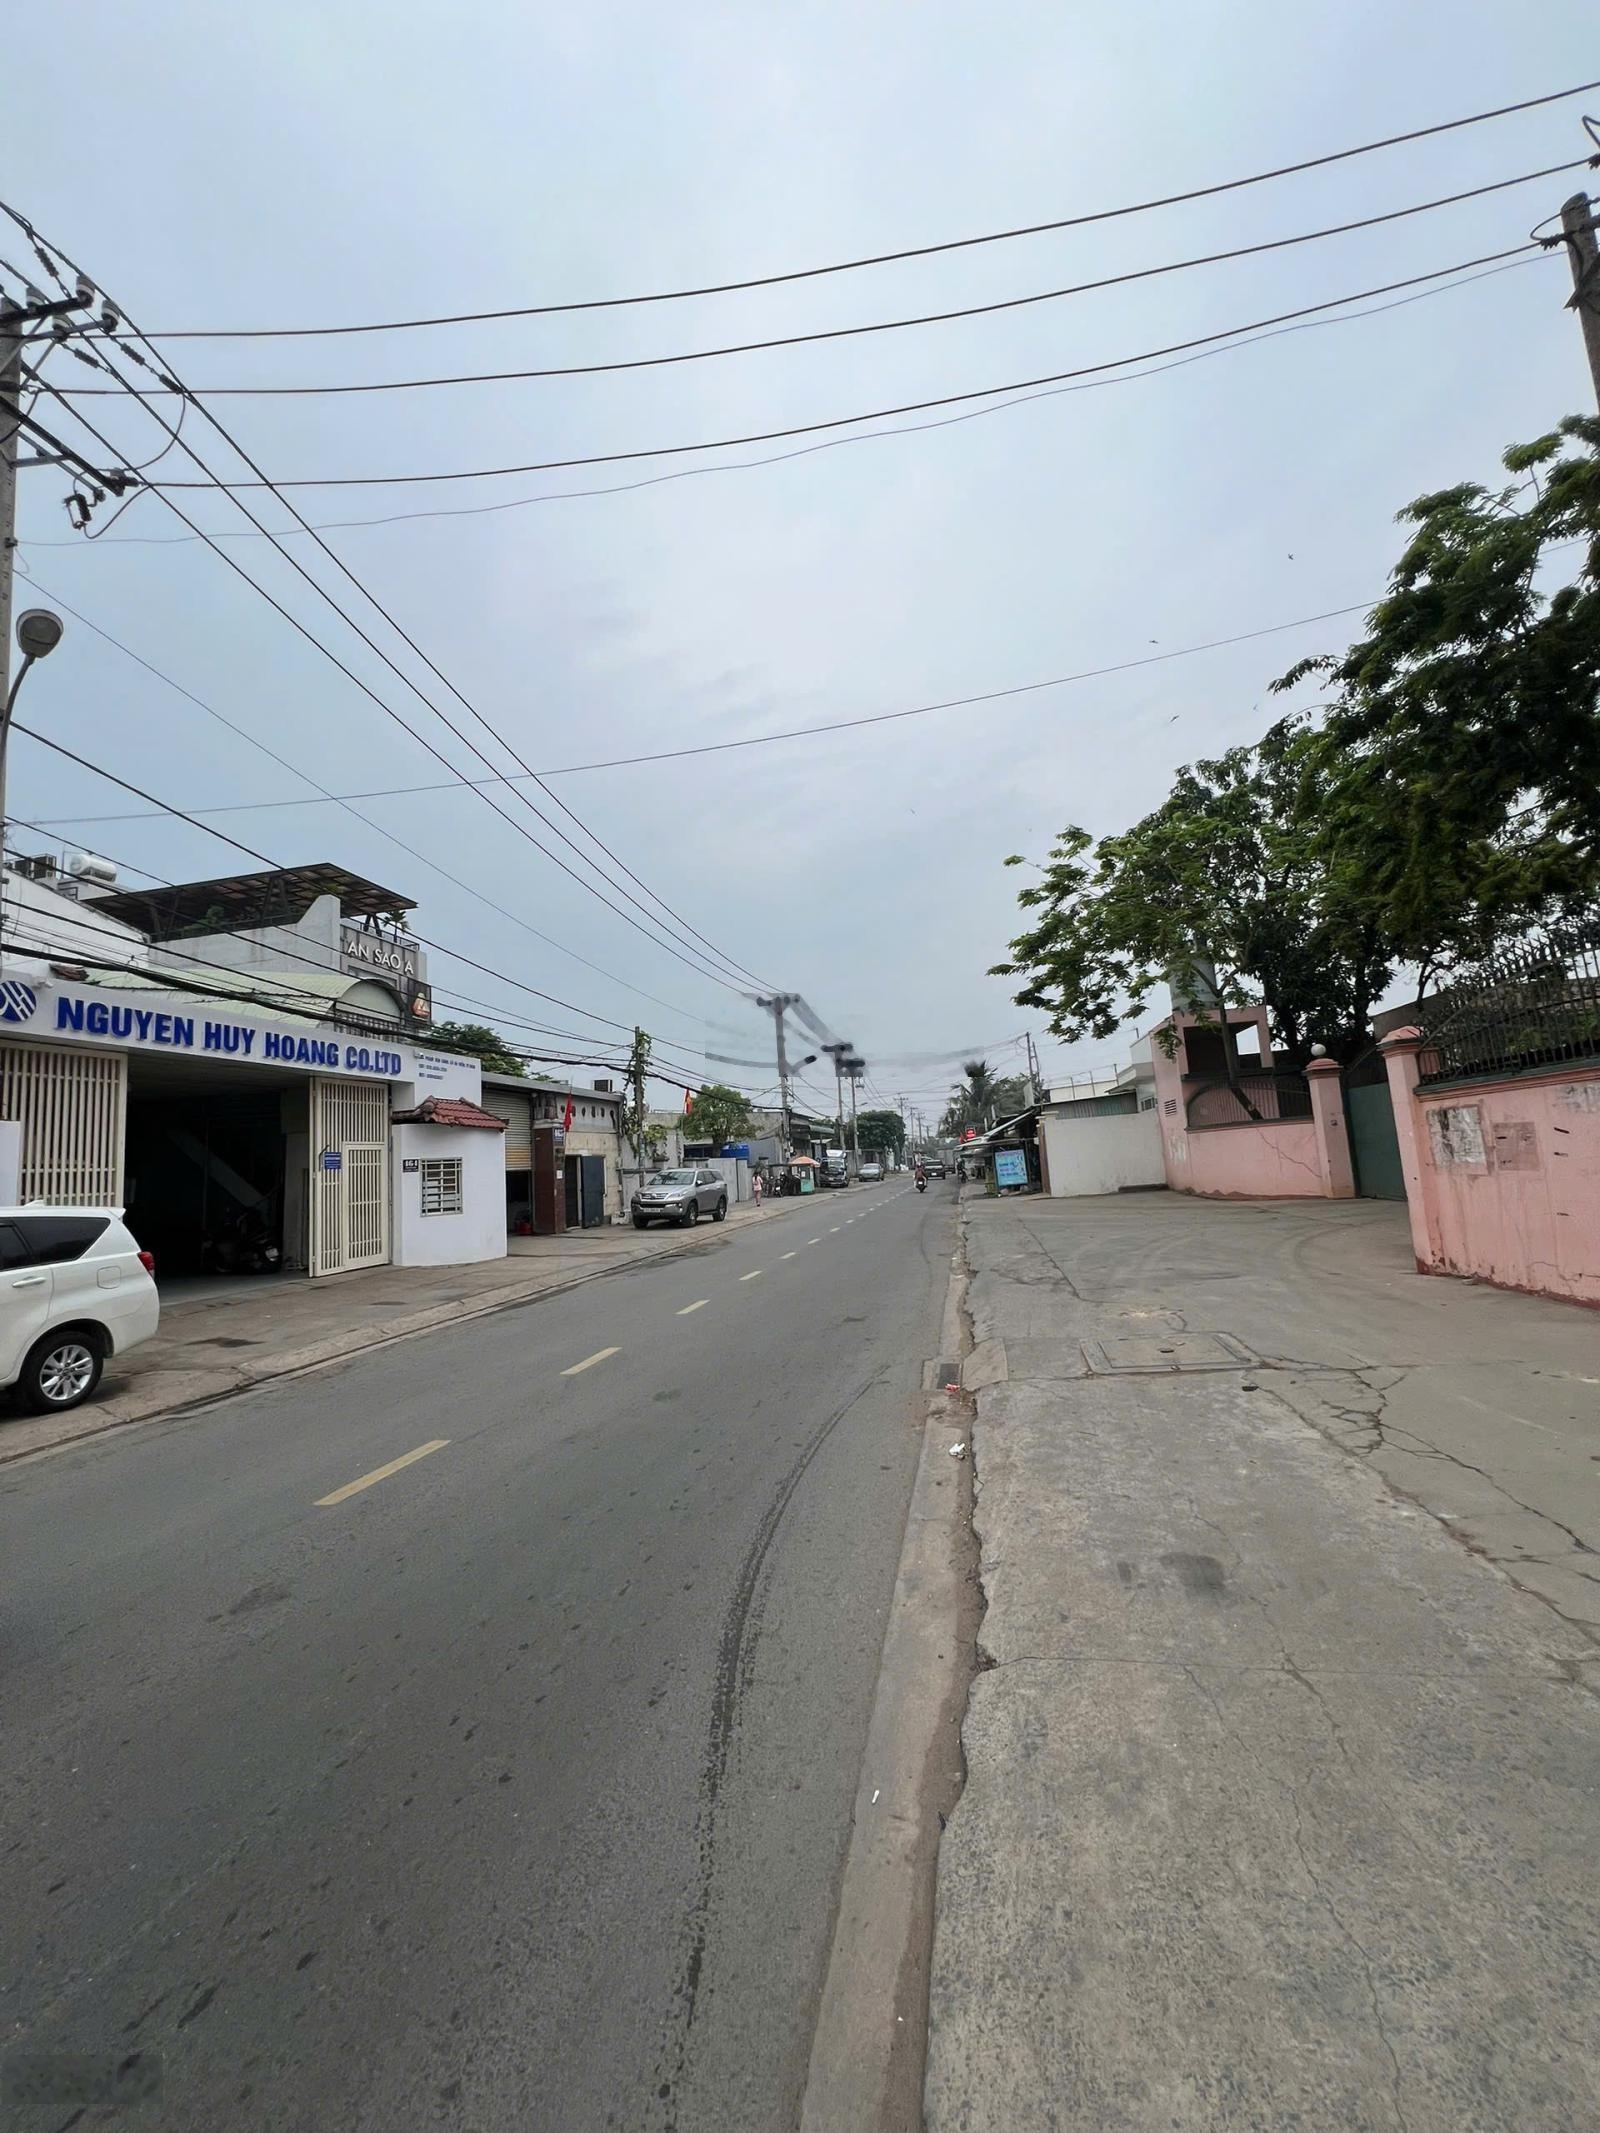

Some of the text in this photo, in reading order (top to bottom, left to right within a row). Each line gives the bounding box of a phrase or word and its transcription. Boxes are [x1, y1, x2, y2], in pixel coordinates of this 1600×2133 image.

[348, 941, 415, 975] AN SAO A
[57, 996, 194, 1046] NGUYEN
[204, 1021, 256, 1054] HUY
[265, 1032, 339, 1067] HOANG
[346, 1046, 402, 1075] CO.LTD
